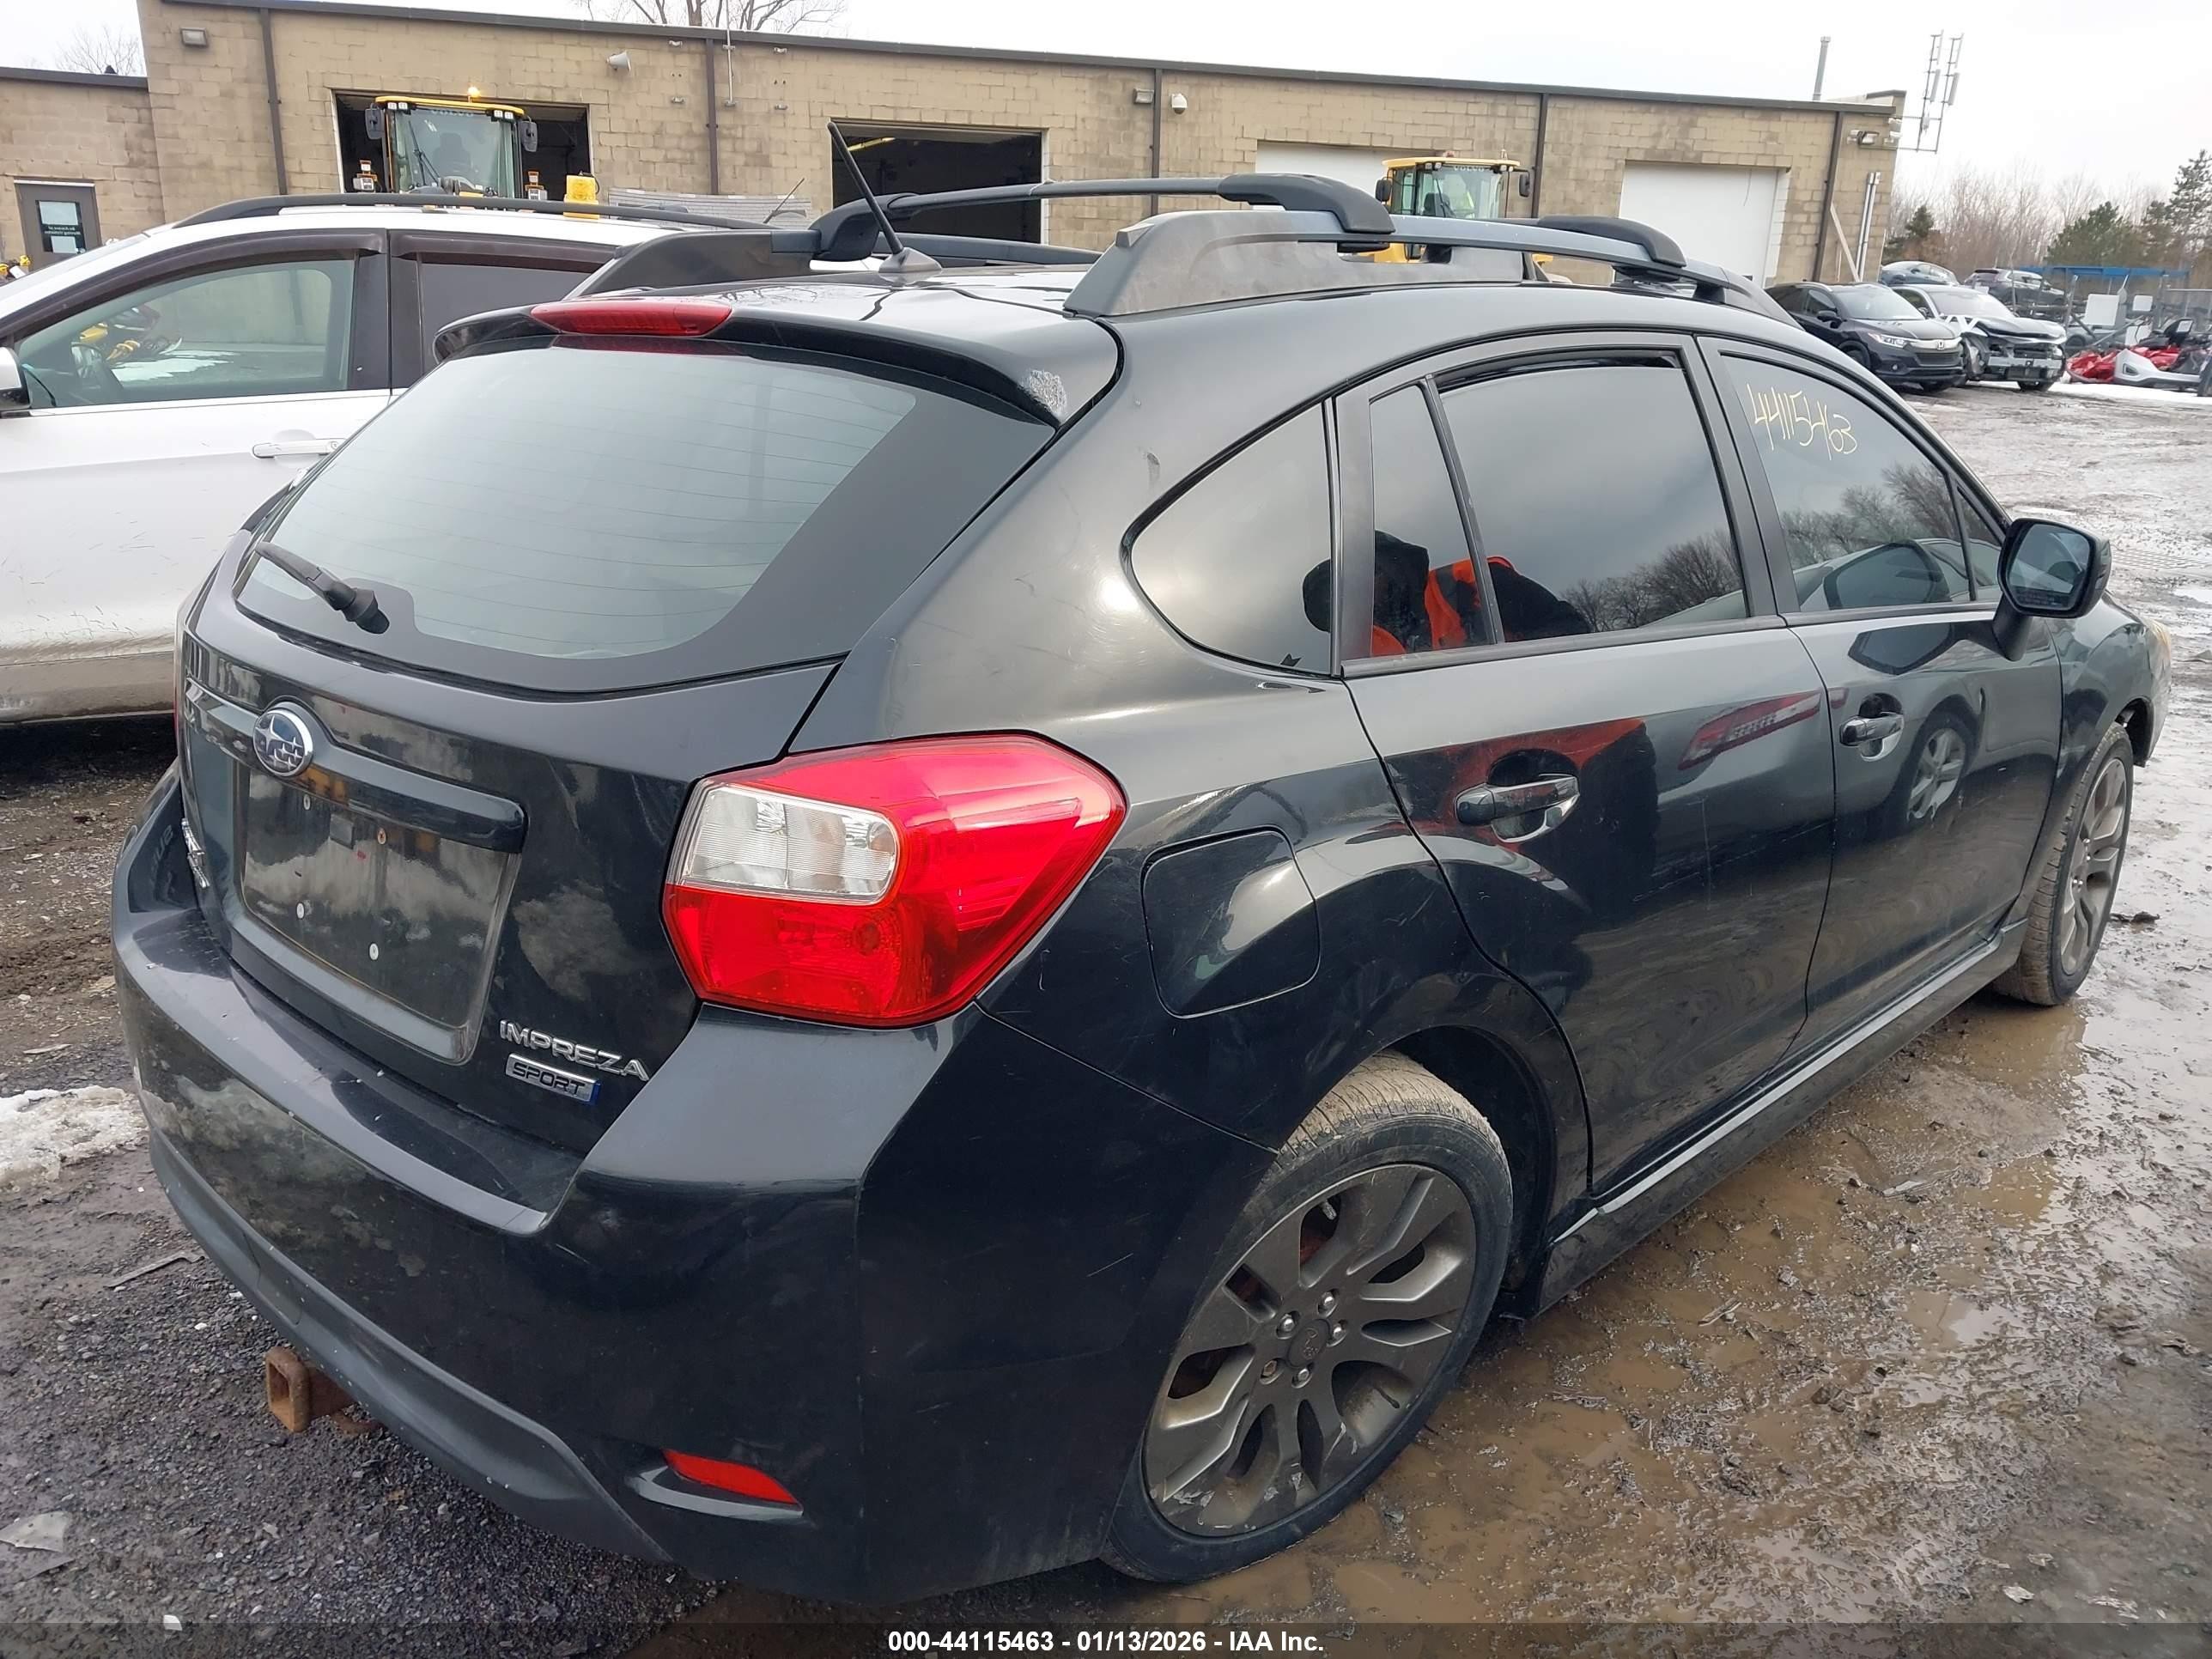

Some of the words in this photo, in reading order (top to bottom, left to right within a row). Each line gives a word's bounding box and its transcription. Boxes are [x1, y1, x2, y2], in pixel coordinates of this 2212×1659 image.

[1747, 383, 1858, 461] 44115463
[500, 1019, 650, 1082] IMPREZA
[513, 1061, 586, 1097] SPORT
